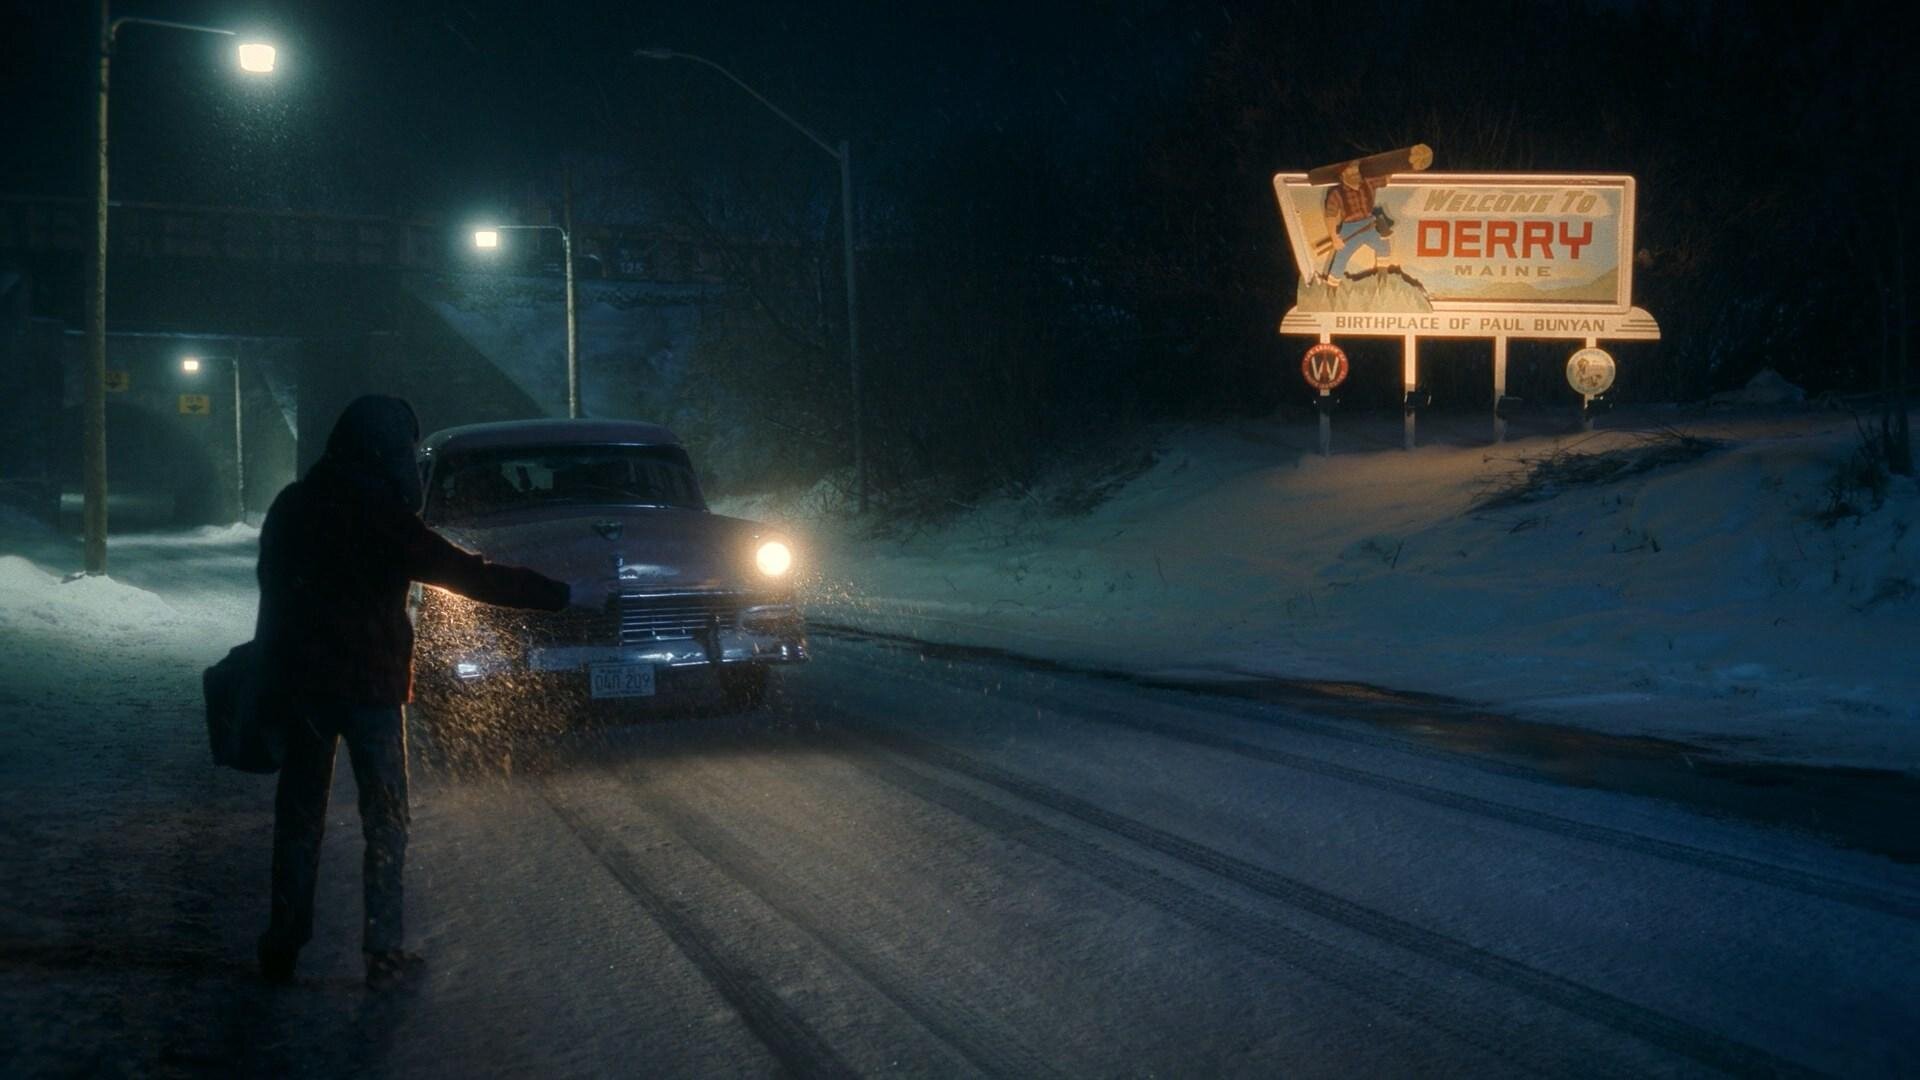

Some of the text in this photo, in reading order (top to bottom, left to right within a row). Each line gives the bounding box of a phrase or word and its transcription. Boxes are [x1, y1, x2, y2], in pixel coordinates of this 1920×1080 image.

[1423, 189, 1598, 213] WELCOME TO
[1417, 220, 1593, 260] DERRY
[1454, 265, 1551, 277] MAINE
[1335, 316, 1605, 332] BIRTHPLACE OF PAUL BUNYAN
